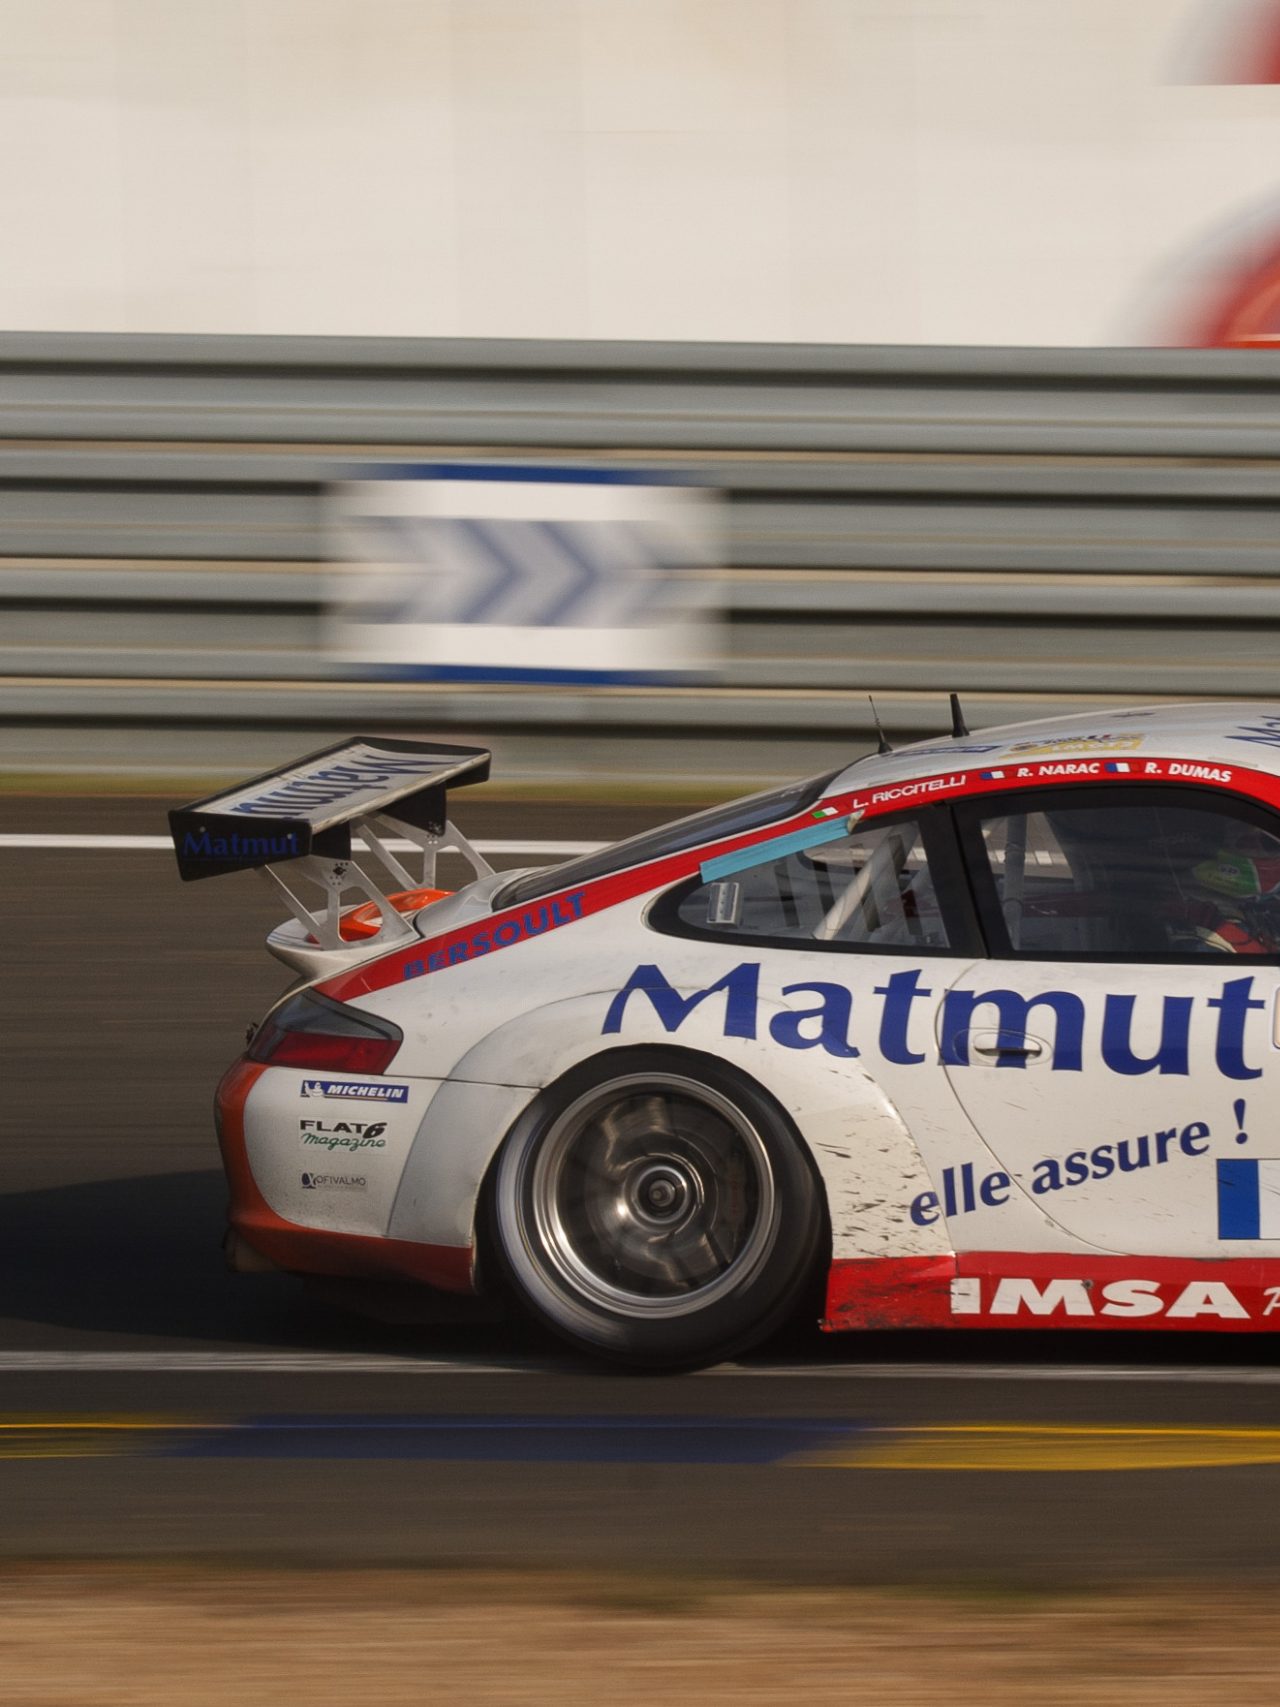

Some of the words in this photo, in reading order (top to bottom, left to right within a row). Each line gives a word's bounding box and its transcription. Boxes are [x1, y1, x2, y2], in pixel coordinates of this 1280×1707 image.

[1017, 767, 1033, 777] R.
[1038, 763, 1100, 776] NARAC
[1145, 762, 1162, 774] R.
[1168, 763, 1233, 783] DUMAS
[229, 754, 456, 820] Matmu
[853, 798, 869, 809] L.
[872, 775, 966, 804] RICCITELLI
[183, 831, 300, 857] Matmut
[600, 962, 1265, 1080] Matmut
[327, 1084, 404, 1099] MICHELIN
[300, 1119, 388, 1139] FLAT6
[301, 1132, 387, 1152] magazine
[909, 1163, 1010, 1226] elle
[1031, 1120, 1211, 1195] assure
[1233, 1098, 1247, 1145] !
[950, 1278, 1251, 1319] IMSA
